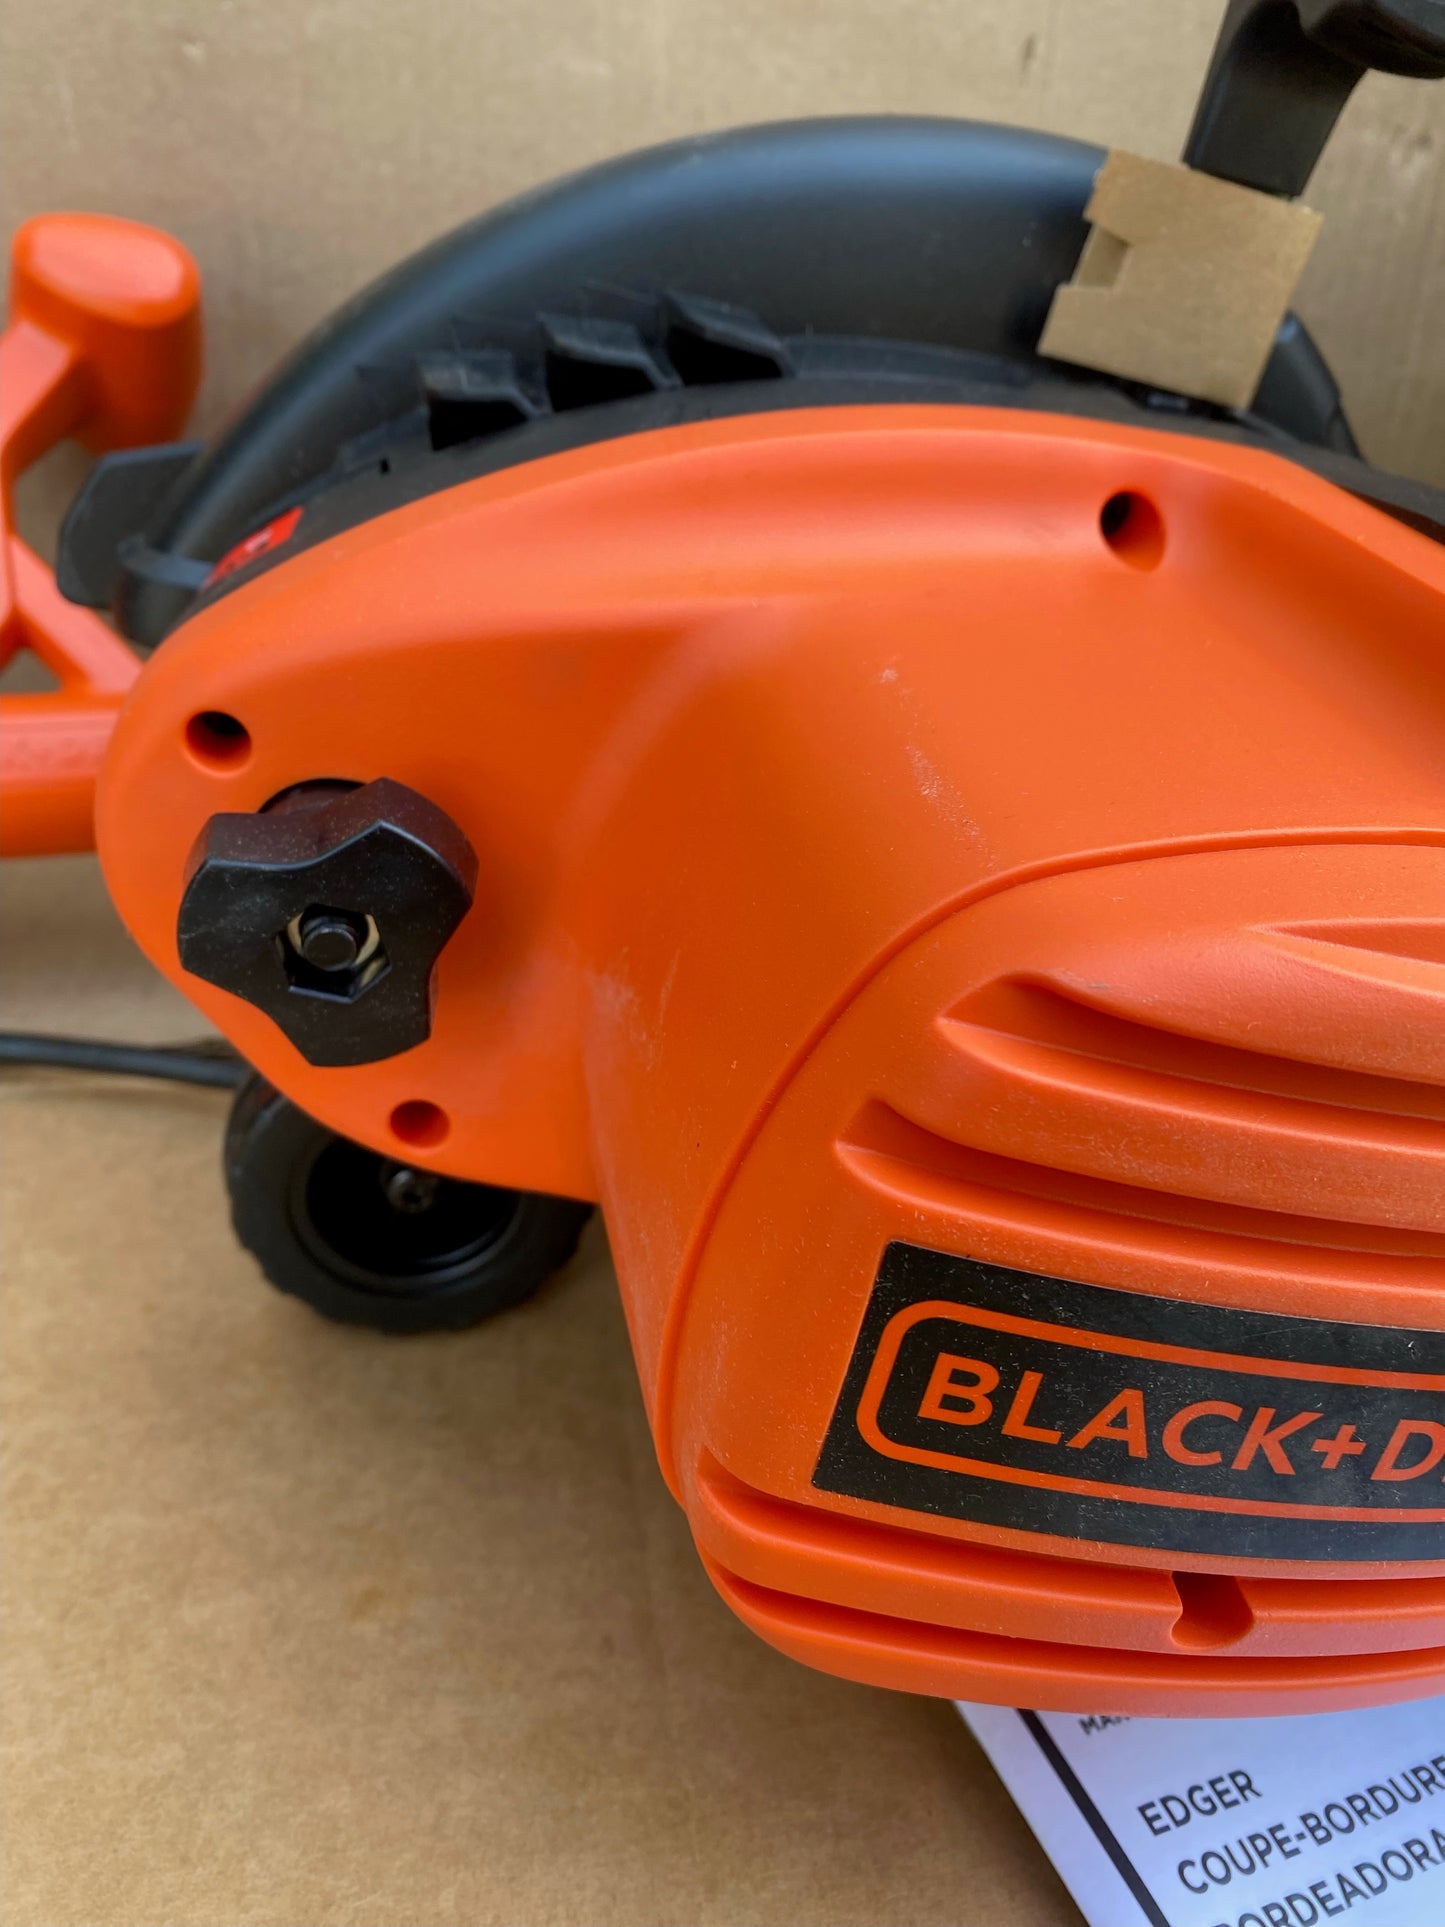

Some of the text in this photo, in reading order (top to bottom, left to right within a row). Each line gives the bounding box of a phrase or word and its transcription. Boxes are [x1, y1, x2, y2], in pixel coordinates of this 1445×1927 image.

[917, 1352, 1445, 1483] BLACK+D
[1137, 1769, 1263, 1836] EDGER
[1212, 1828, 1445, 1927] RDEADORA
